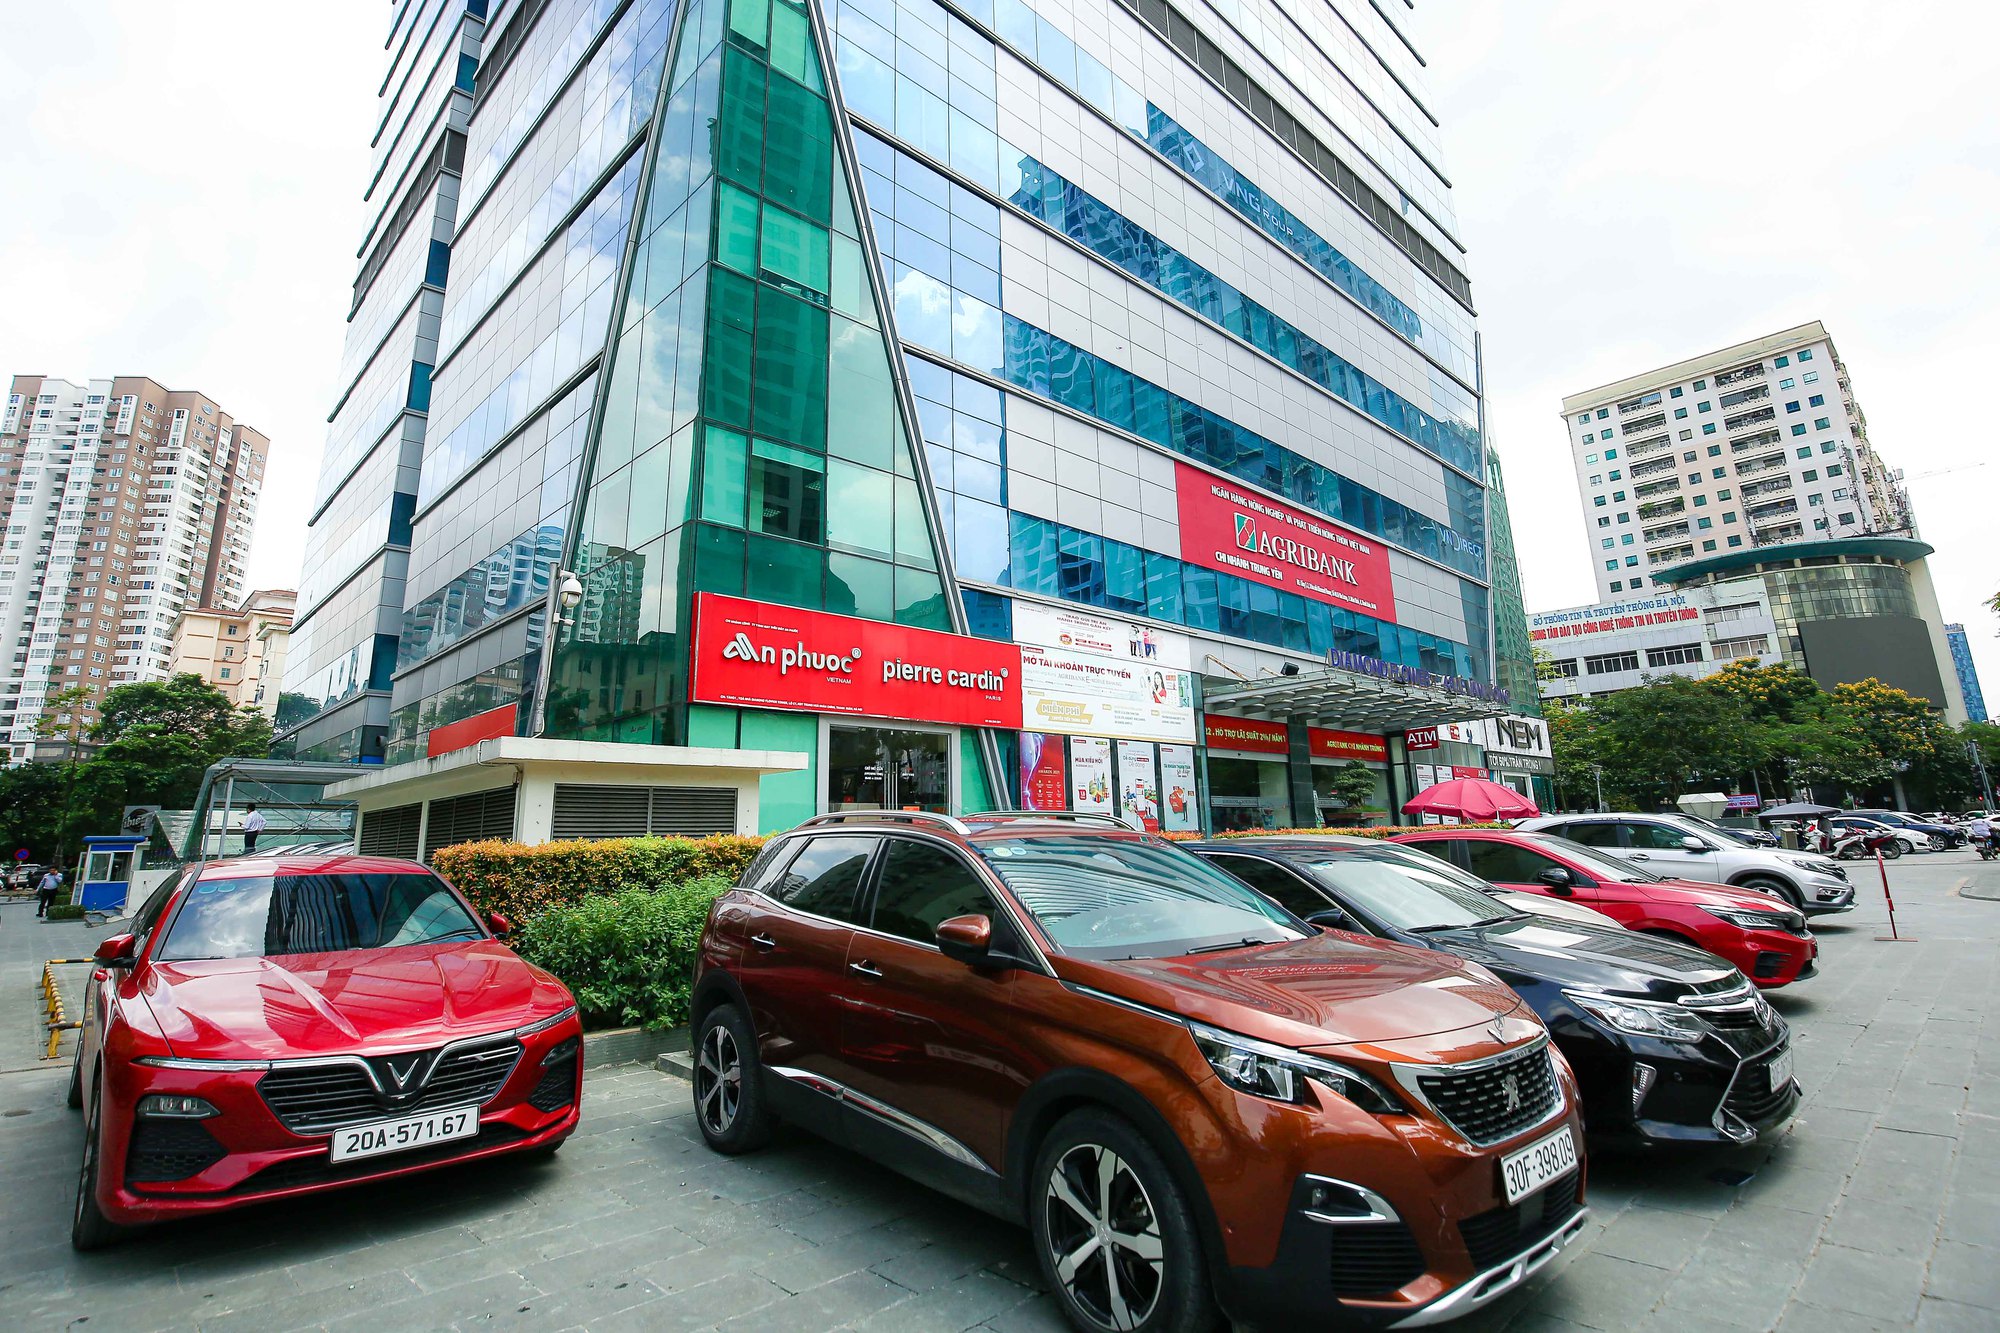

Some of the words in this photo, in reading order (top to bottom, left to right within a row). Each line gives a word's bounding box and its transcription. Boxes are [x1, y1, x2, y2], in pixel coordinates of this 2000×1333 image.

[1211, 485, 1230, 500] NGÂN
[1230, 492, 1248, 507] HÀNG
[1248, 499, 1265, 513] NÔNG
[1265, 506, 1285, 522] NGHIỆP
[1285, 513, 1294, 525] VÀ
[1293, 518, 1307, 529] PHÁT
[1215, 551, 1227, 563] CHI
[1226, 554, 1250, 570] NHÁNH
[1249, 561, 1270, 577] TRUNG
[1258, 530, 1358, 586] AGRIBANK
[1533, 613, 1543, 626] SỞ
[1544, 612, 1569, 625] THÔNG
[1569, 610, 1582, 621] TIN
[1583, 607, 1593, 619] VÀ
[1626, 599, 1655, 612] THÔNG
[1670, 594, 1686, 606] NỘI
[1547, 625, 1559, 639] TÂM
[1571, 622, 1583, 637] TẠO
[1583, 620, 1599, 634] CÔNG
[1615, 615, 1635, 629] THÔNG
[1634, 614, 1645, 627] TIN
[1645, 611, 1655, 625] VÀ
[1678, 606, 1698, 620] THÔNG
[883, 658, 942, 683] pierre
[947, 668, 1004, 692] cardin
[1023, 654, 1037, 665] MỞ
[1039, 657, 1052, 668] TÀI
[1054, 660, 1083, 672] KHOẢN
[1085, 665, 1105, 677] TRỰC
[1107, 668, 1131, 679] TUYẾN
[1329, 648, 1388, 678] DIAMOND
[826, 676, 852, 685] VIETNAM
[985, 694, 1002, 702] PARIS
[1407, 730, 1437, 744] ATM
[1496, 718, 1543, 751] NEM
[346, 1113, 467, 1154] 20A-571.67
[1506, 1133, 1575, 1196] 30F-398.09
